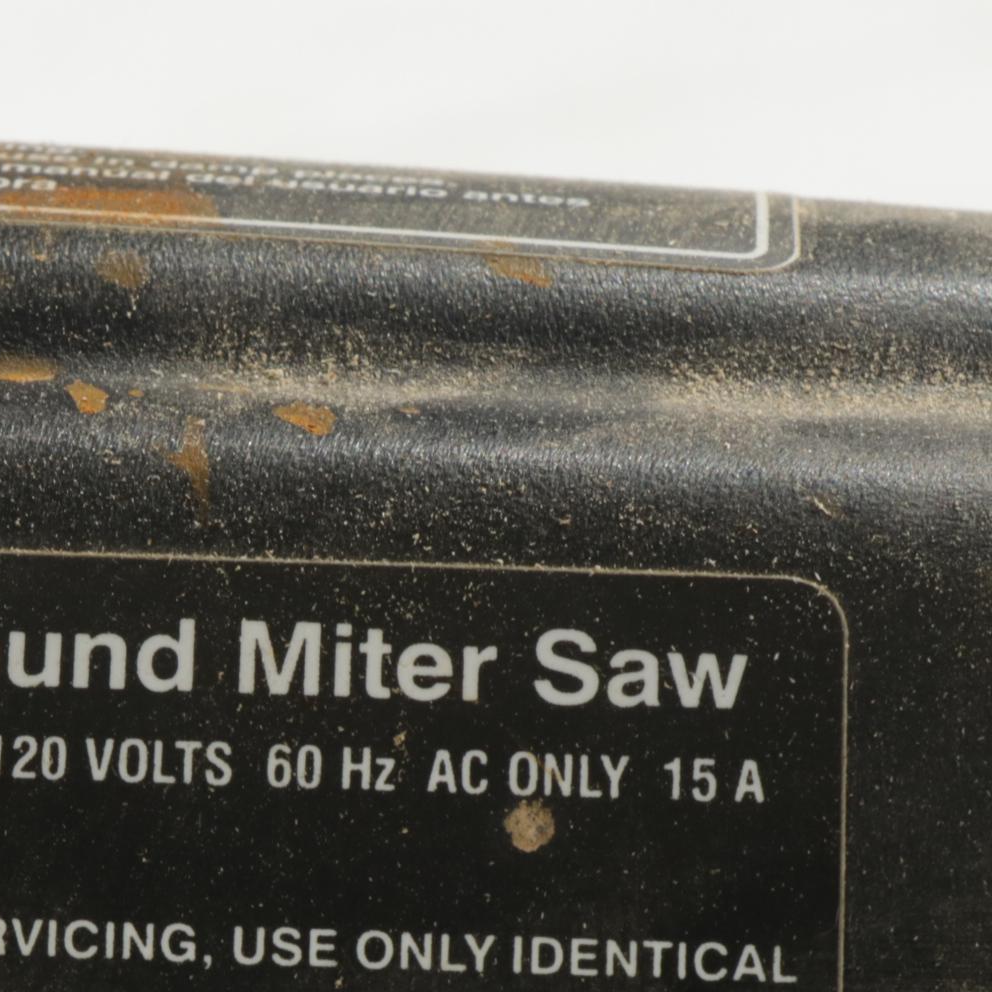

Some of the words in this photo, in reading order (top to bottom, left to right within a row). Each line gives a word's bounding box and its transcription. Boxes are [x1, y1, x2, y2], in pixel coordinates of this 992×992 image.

[237, 617, 498, 704] Miter
[533, 628, 748, 710] Saw
[85, 737, 234, 787] VOLTS
[266, 744, 323, 790] 60
[341, 746, 397, 792] Hz
[426, 749, 489, 796] AC
[508, 751, 631, 800] ONLY
[662, 757, 718, 803] 15
[733, 758, 766, 804] A
[232, 926, 338, 968] USE
[355, 930, 497, 973] ONLY
[511, 936, 798, 984] IDENTICAL
